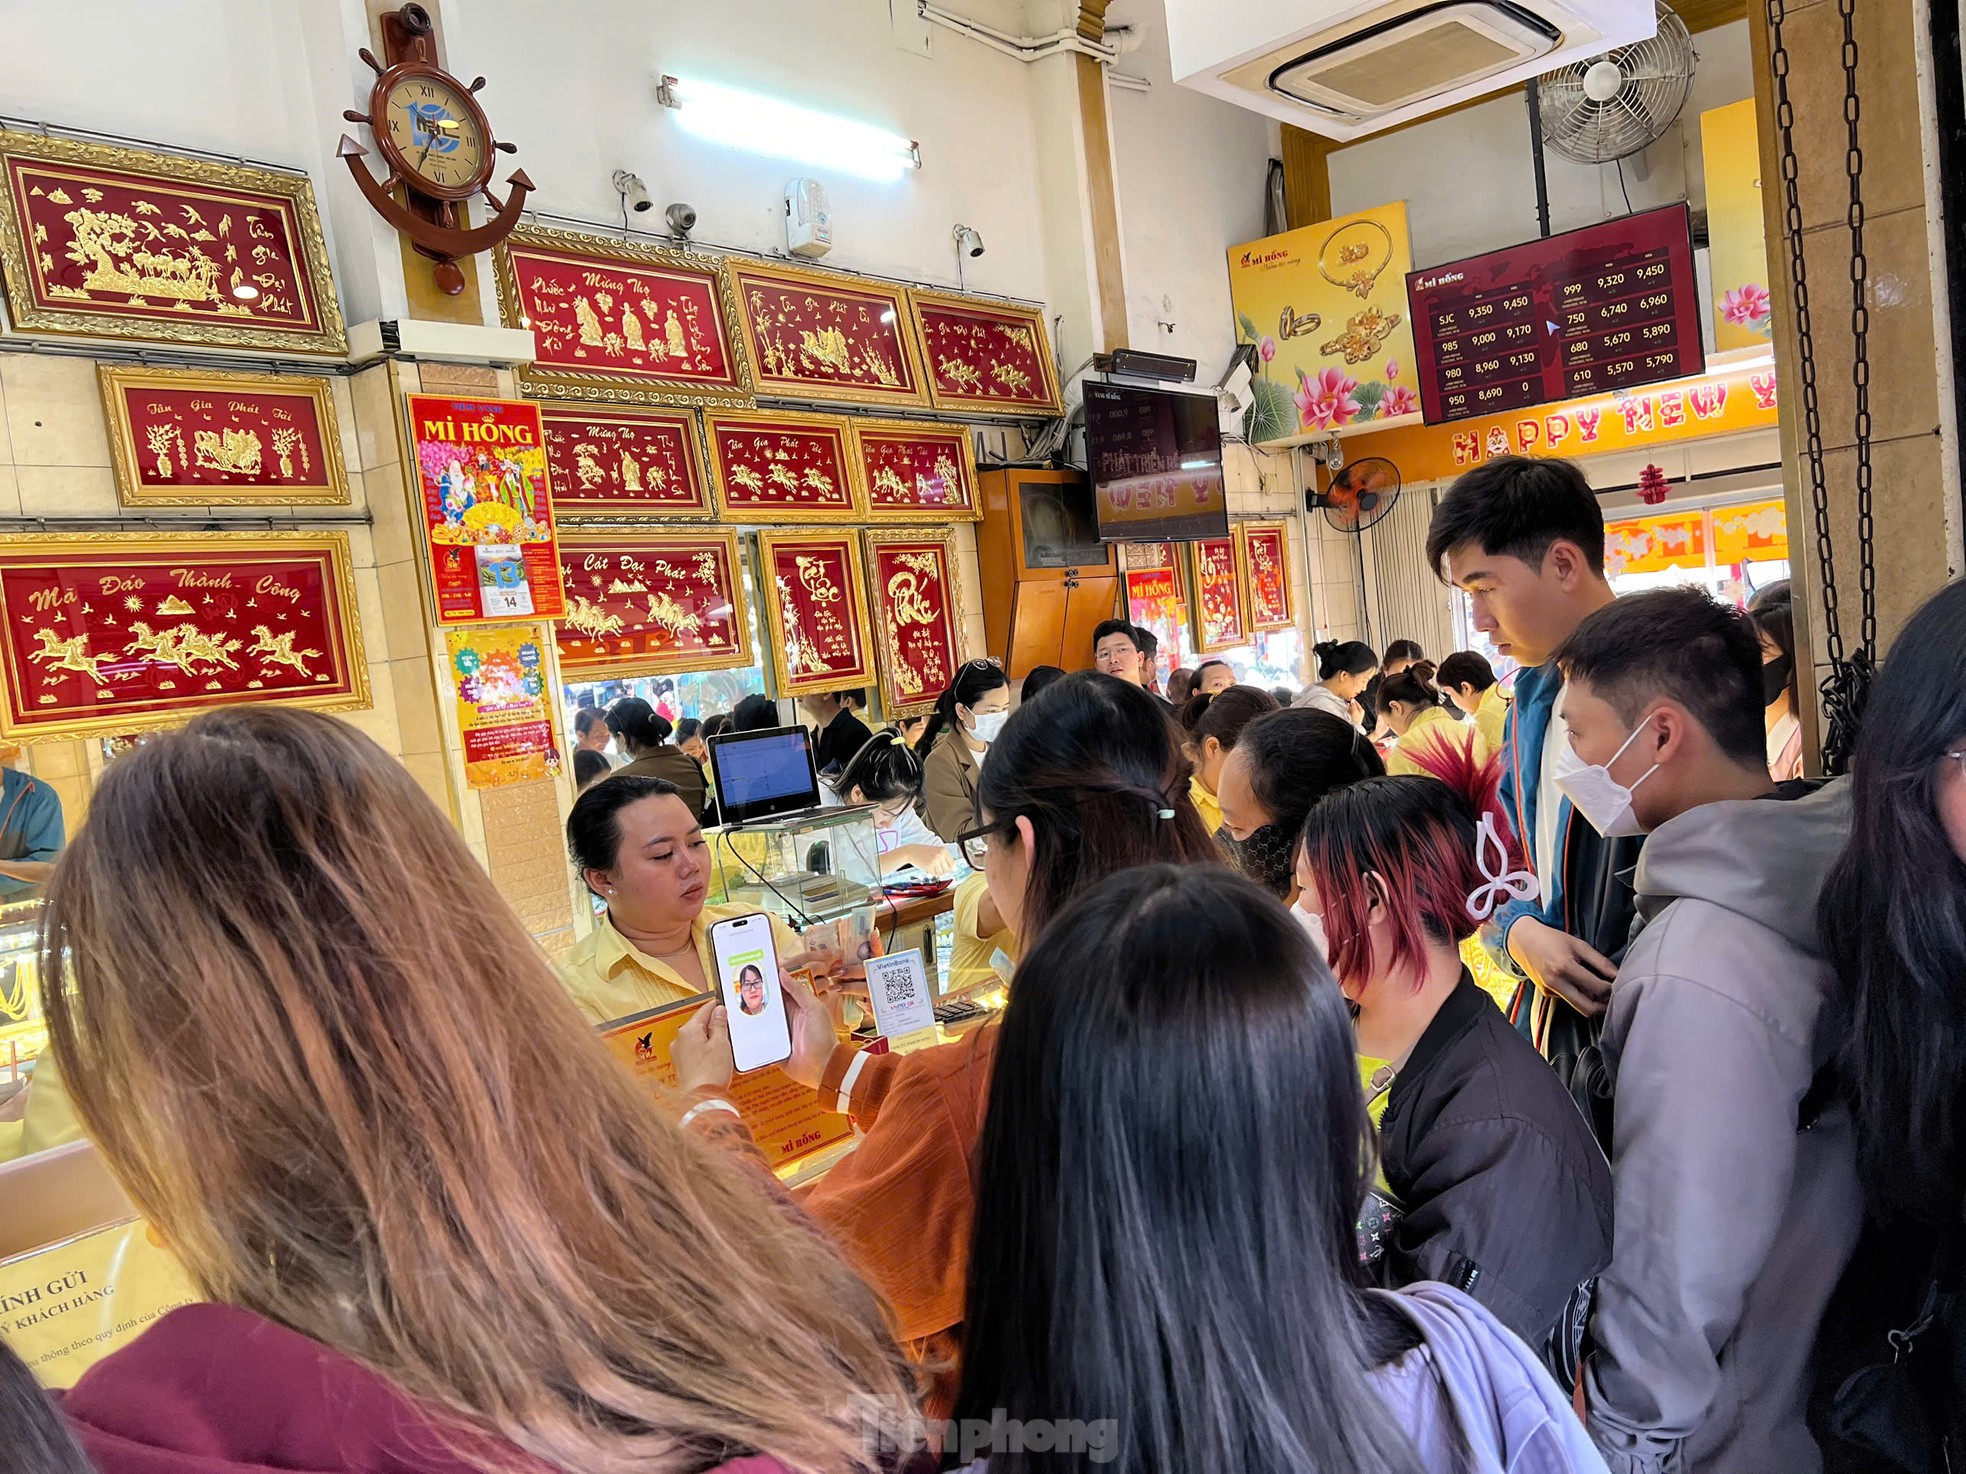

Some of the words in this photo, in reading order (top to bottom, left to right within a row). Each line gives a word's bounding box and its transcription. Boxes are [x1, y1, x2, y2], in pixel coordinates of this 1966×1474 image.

[420, 85, 434, 98] XII
[388, 120, 399, 132] IX
[466, 136, 475, 148] III
[434, 171, 445, 183] VI
[582, 271, 624, 295] Mừng
[627, 278, 650, 298] Thọ
[1563, 284, 1582, 296] 999
[1597, 273, 1624, 288] 9,320
[1636, 264, 1665, 279] 9,450
[1439, 313, 1455, 325] SJC
[1468, 304, 1493, 319] 9,350
[1503, 296, 1528, 311] 9,450
[1567, 312, 1585, 325] 750
[1601, 303, 1628, 317] 6,740
[1640, 294, 1667, 309] 6,960
[1442, 341, 1458, 352] 985
[1471, 332, 1496, 347] 9,000
[1506, 325, 1531, 339] 9,170
[1570, 341, 1588, 353] 680
[1604, 332, 1631, 347] 5,670
[1643, 324, 1670, 338] 5,890
[1445, 368, 1462, 379] 980
[1475, 360, 1499, 374] 8,960
[1509, 352, 1535, 366] 9,130
[1573, 370, 1591, 382] 610
[1607, 361, 1634, 375] 5,570
[1646, 353, 1673, 368] 5,790
[1448, 394, 1465, 406] 950
[1478, 387, 1502, 401] 8,690
[1522, 382, 1529, 392] 0
[147, 403, 173, 415] Tân
[190, 399, 213, 411] Gia
[227, 401, 260, 414] Phát
[272, 408, 291, 421] Tài
[1617, 382, 1726, 434] NEW
[461, 413, 533, 444] HỒNG
[488, 561, 520, 589] 13
[584, 554, 609, 571] Cát
[620, 556, 645, 572] Đại
[655, 560, 686, 580] Phát
[29, 586, 78, 612] Mã
[99, 573, 146, 596] Đáo
[169, 568, 233, 589] Thành
[255, 574, 301, 604] Công
[504, 597, 517, 608] 14
[0, 1287, 42, 1314] ÍNH
[46, 1270, 88, 1295] GỬI
[16, 1301, 69, 1329] KHÁCH
[73, 1285, 115, 1309] HÀNG
[95, 1329, 113, 1342] quy
[115, 1318, 137, 1333] định
